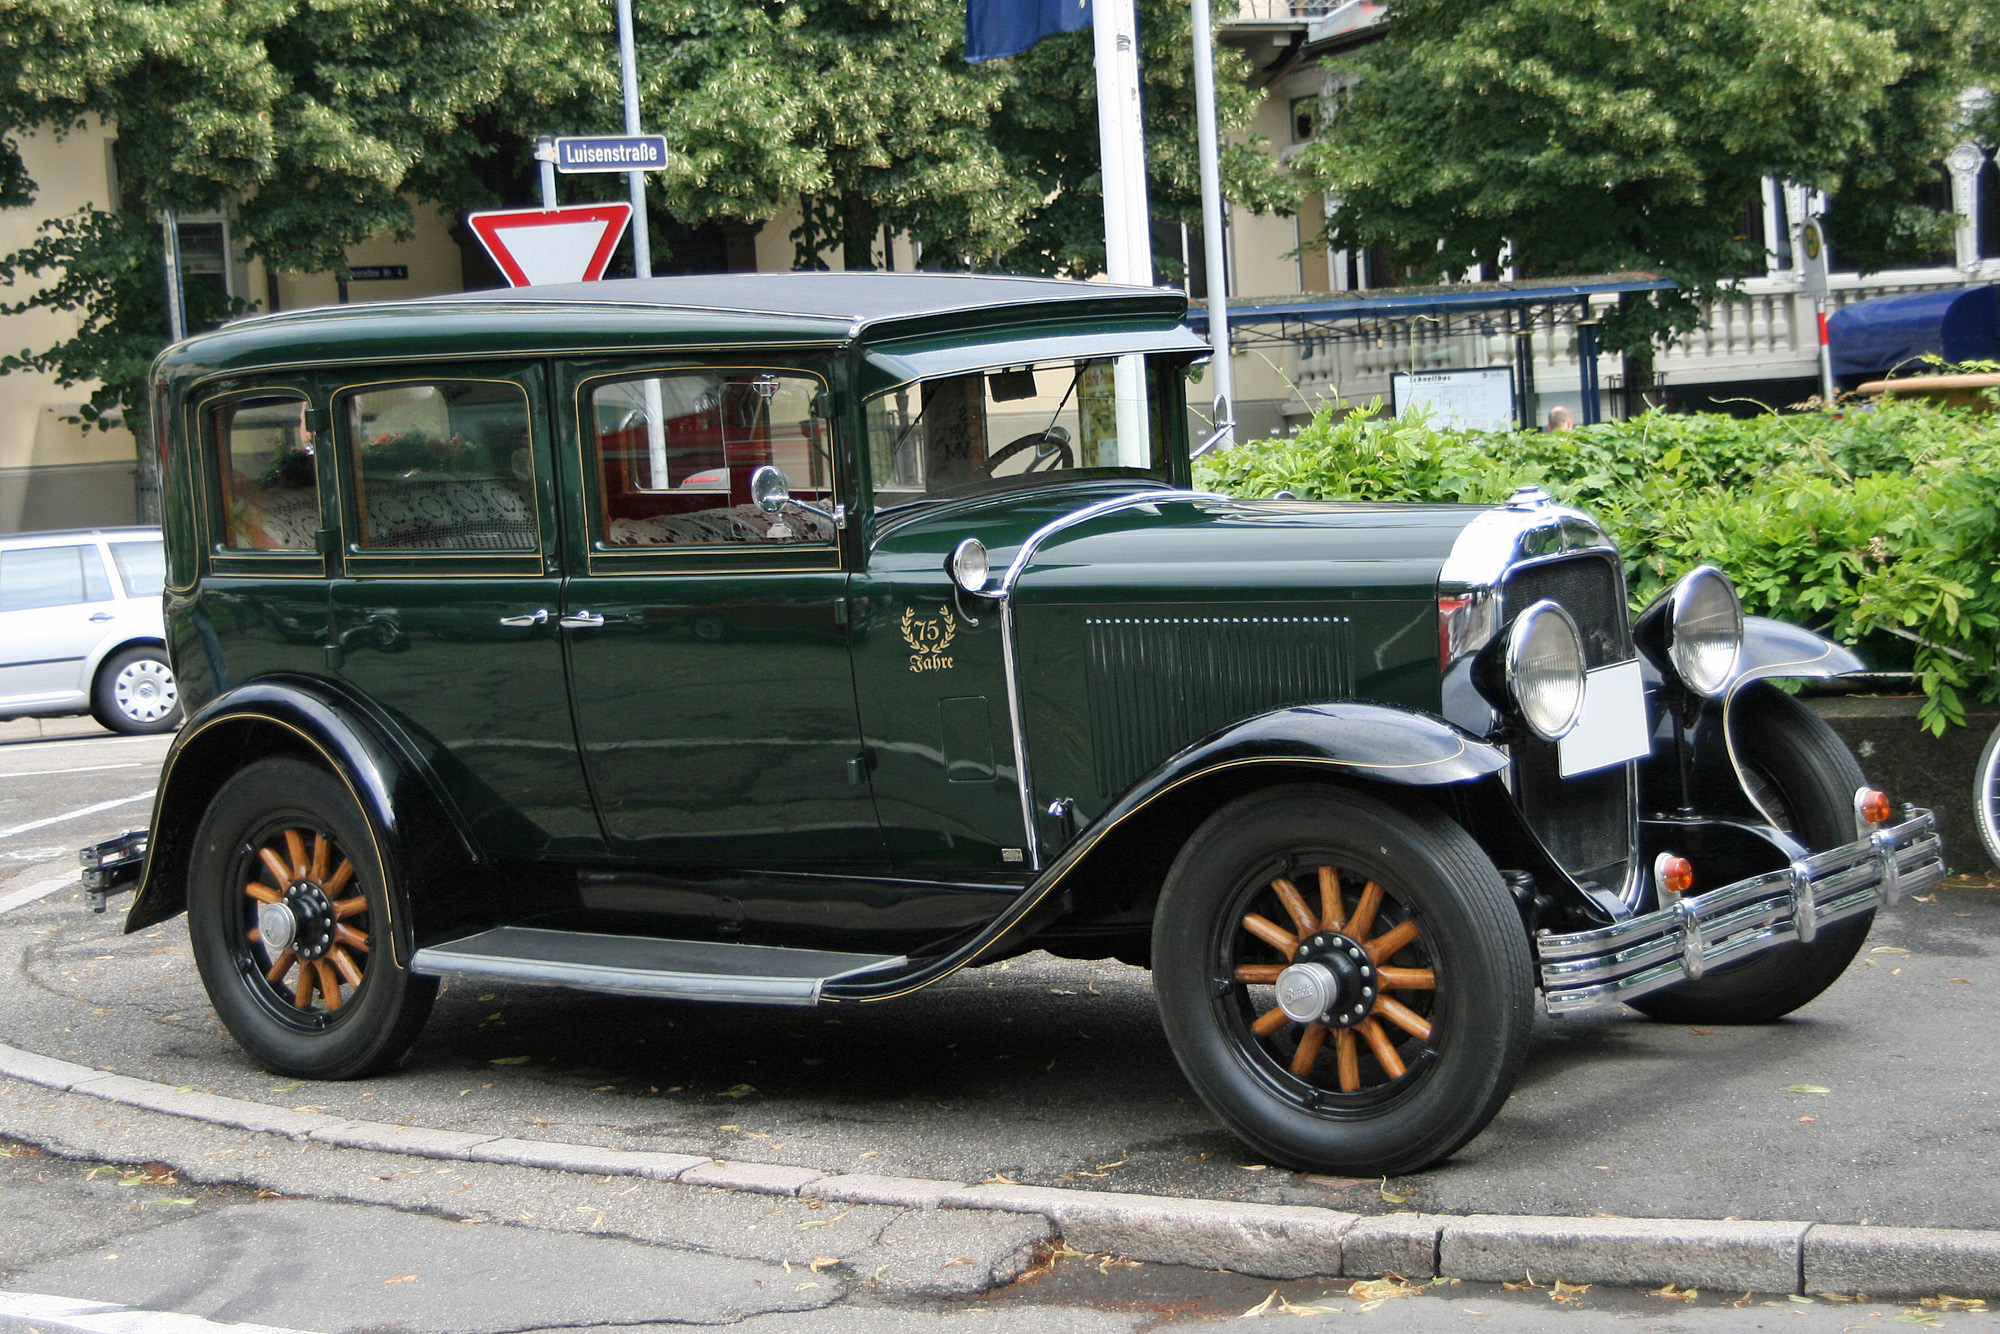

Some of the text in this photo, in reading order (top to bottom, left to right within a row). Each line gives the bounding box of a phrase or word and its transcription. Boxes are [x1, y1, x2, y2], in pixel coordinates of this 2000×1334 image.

[566, 143, 658, 164] Luisenstraße
[914, 619, 940, 641] 75
[909, 653, 955, 673] Jahre
